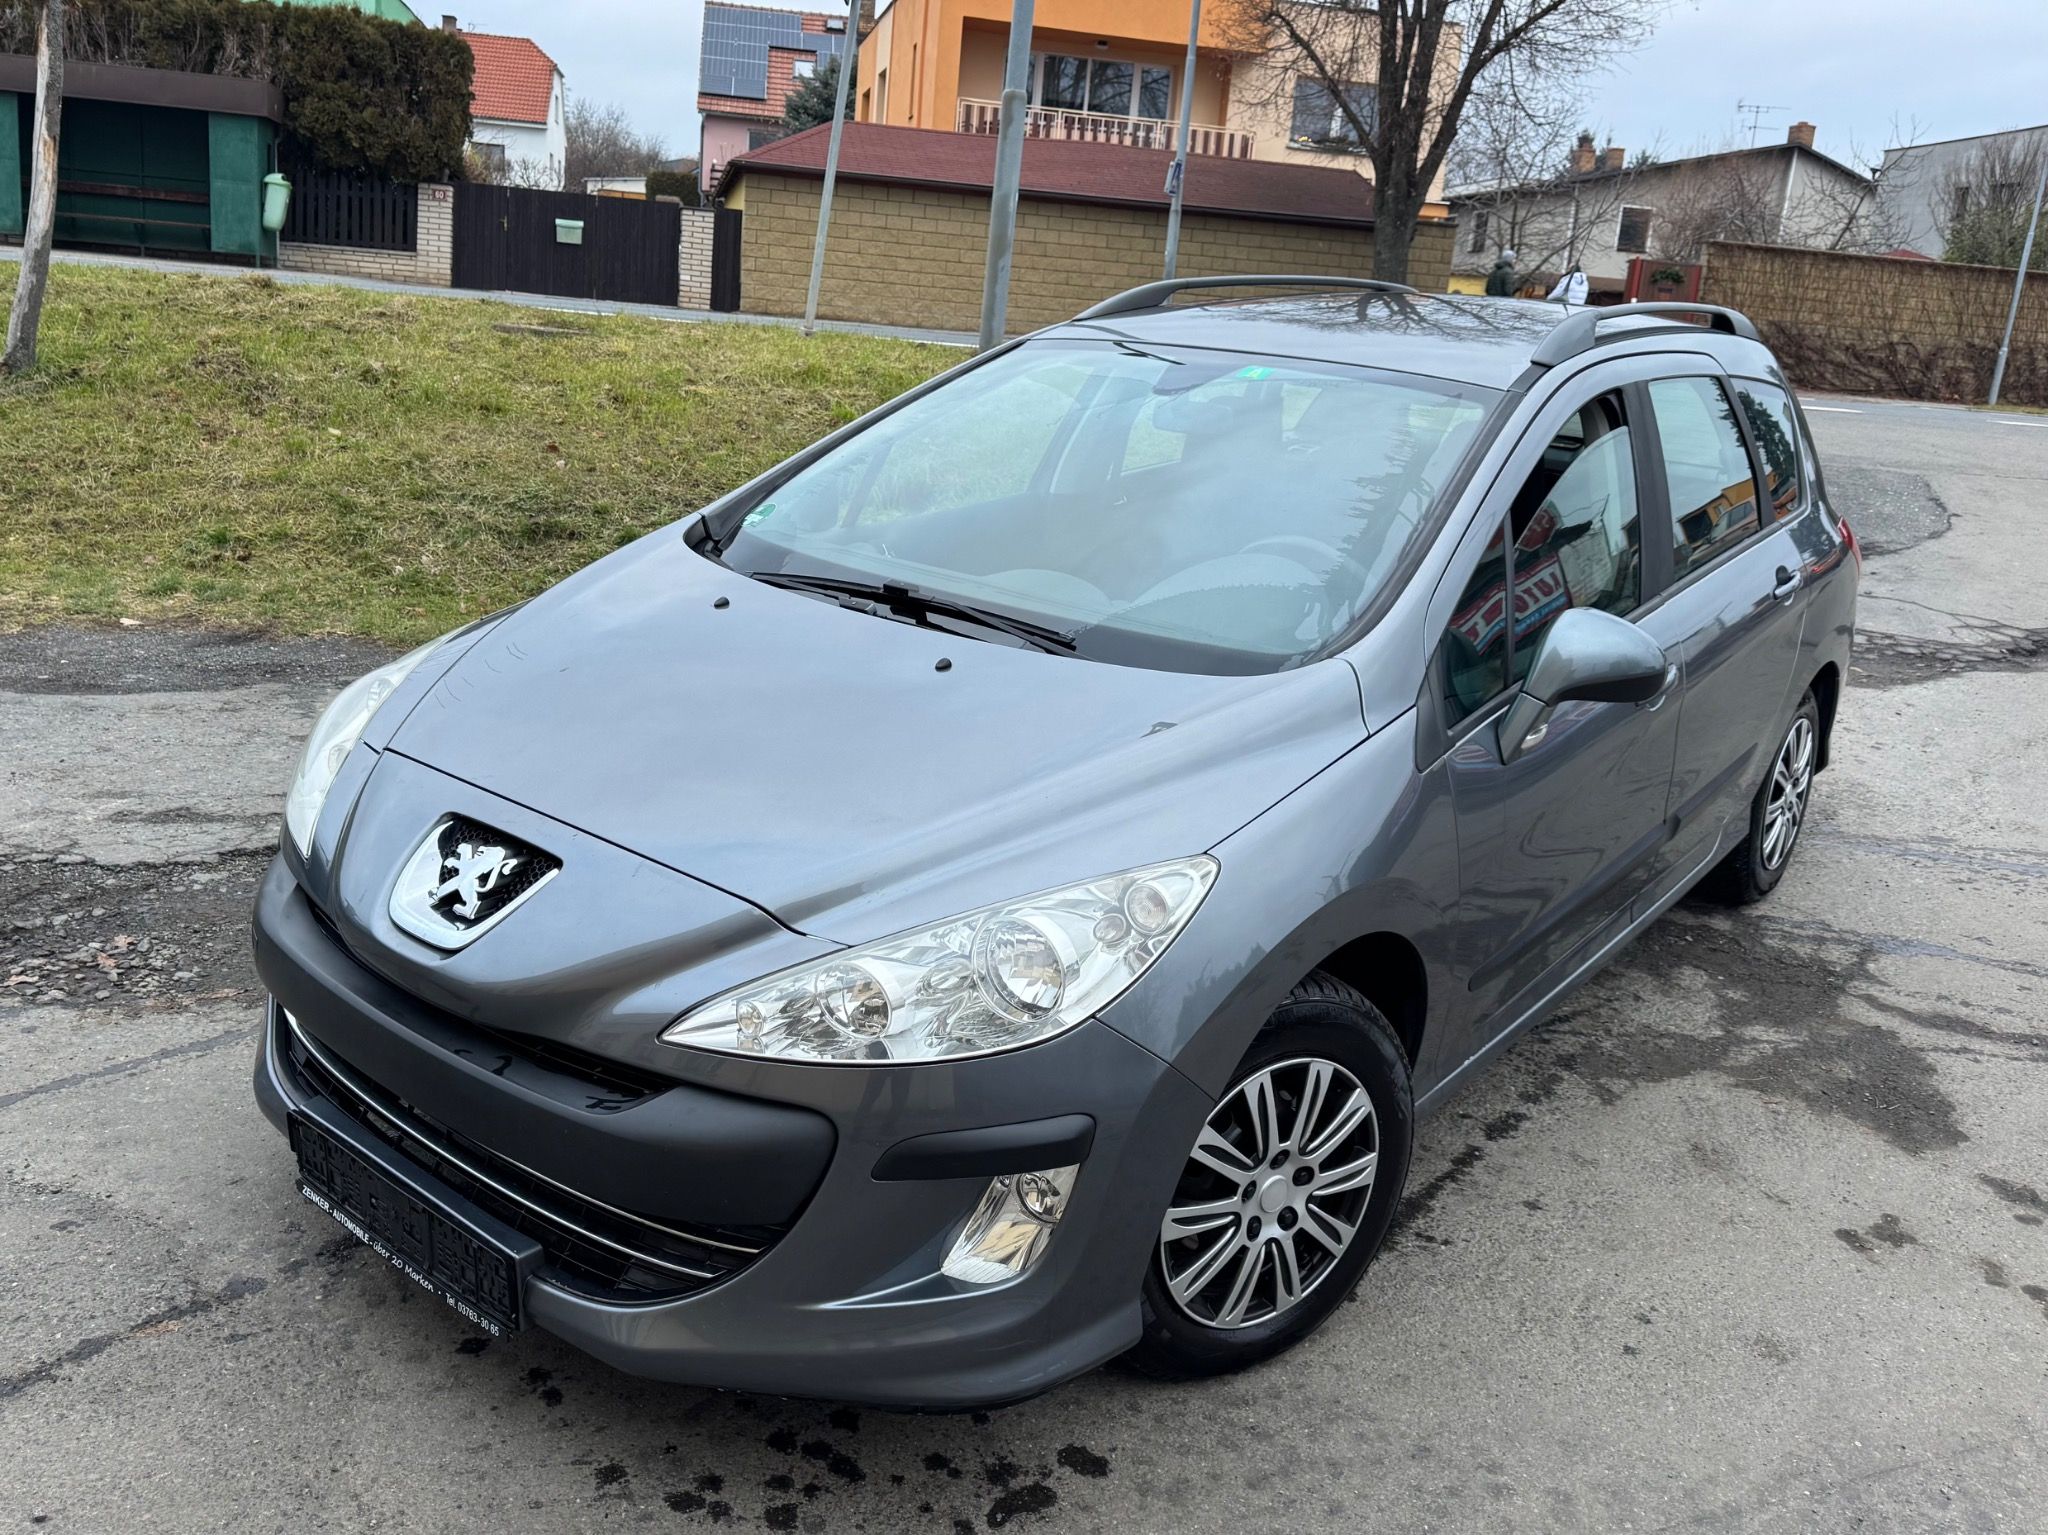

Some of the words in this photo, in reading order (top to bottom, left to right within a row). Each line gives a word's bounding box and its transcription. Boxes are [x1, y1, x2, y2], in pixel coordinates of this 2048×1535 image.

[373, 1241, 390, 1259] über
[391, 1256, 403, 1268] 20
[405, 1264, 434, 1292] Marken
